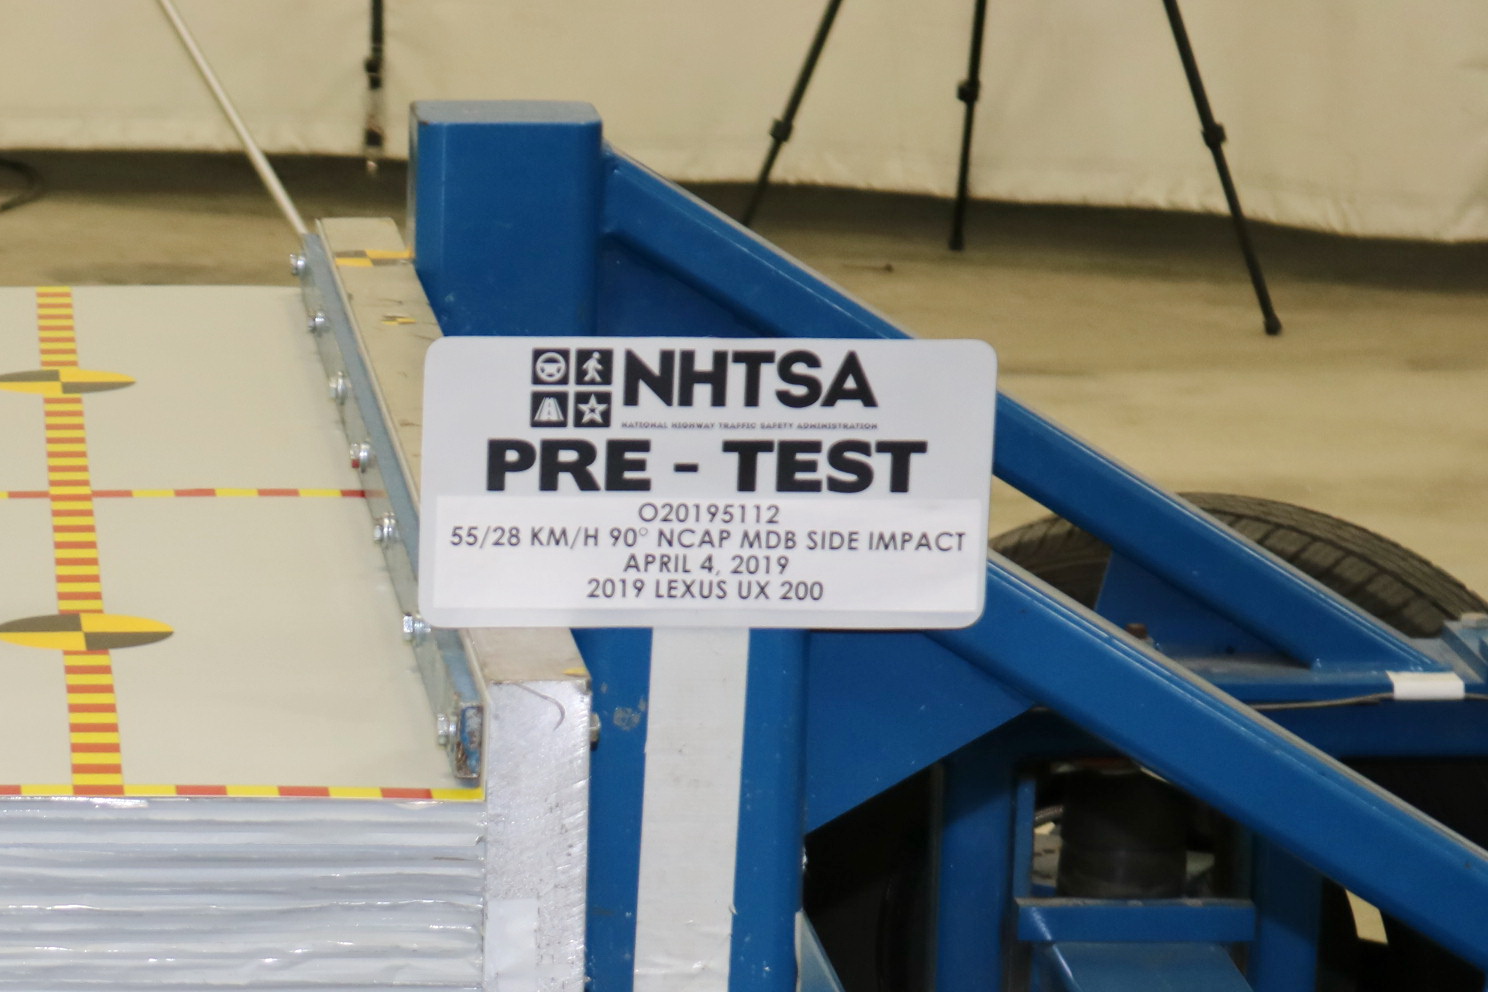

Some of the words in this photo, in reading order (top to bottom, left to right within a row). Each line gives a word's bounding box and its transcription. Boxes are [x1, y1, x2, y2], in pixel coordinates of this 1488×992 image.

[623, 349, 879, 409] NHTSA
[621, 421, 668, 430] NATIONAL
[671, 421, 715, 430] HIGHWAY
[718, 421, 756, 430] TRAFFIC
[760, 421, 793, 430] SAFETY
[796, 421, 878, 431] ADMINISTRATION
[486, 438, 652, 492] PRE
[673, 462, 699, 474] -
[722, 439, 928, 494] TEST
[450, 525, 521, 548] 55/28
[531, 527, 599, 549] KM/H
[609, 527, 649, 549] 90°
[657, 528, 731, 550] NCAP
[740, 530, 797, 550] MDB
[807, 531, 859, 552] SIDE
[868, 532, 966, 553] IMPACT
[623, 553, 691, 574] APRIL
[700, 554, 721, 578] 4,
[731, 555, 790, 576] 2019
[587, 577, 645, 599] 2019
[655, 579, 727, 601] LEXUS
[738, 580, 770, 601] UX
[779, 581, 824, 602] 200
